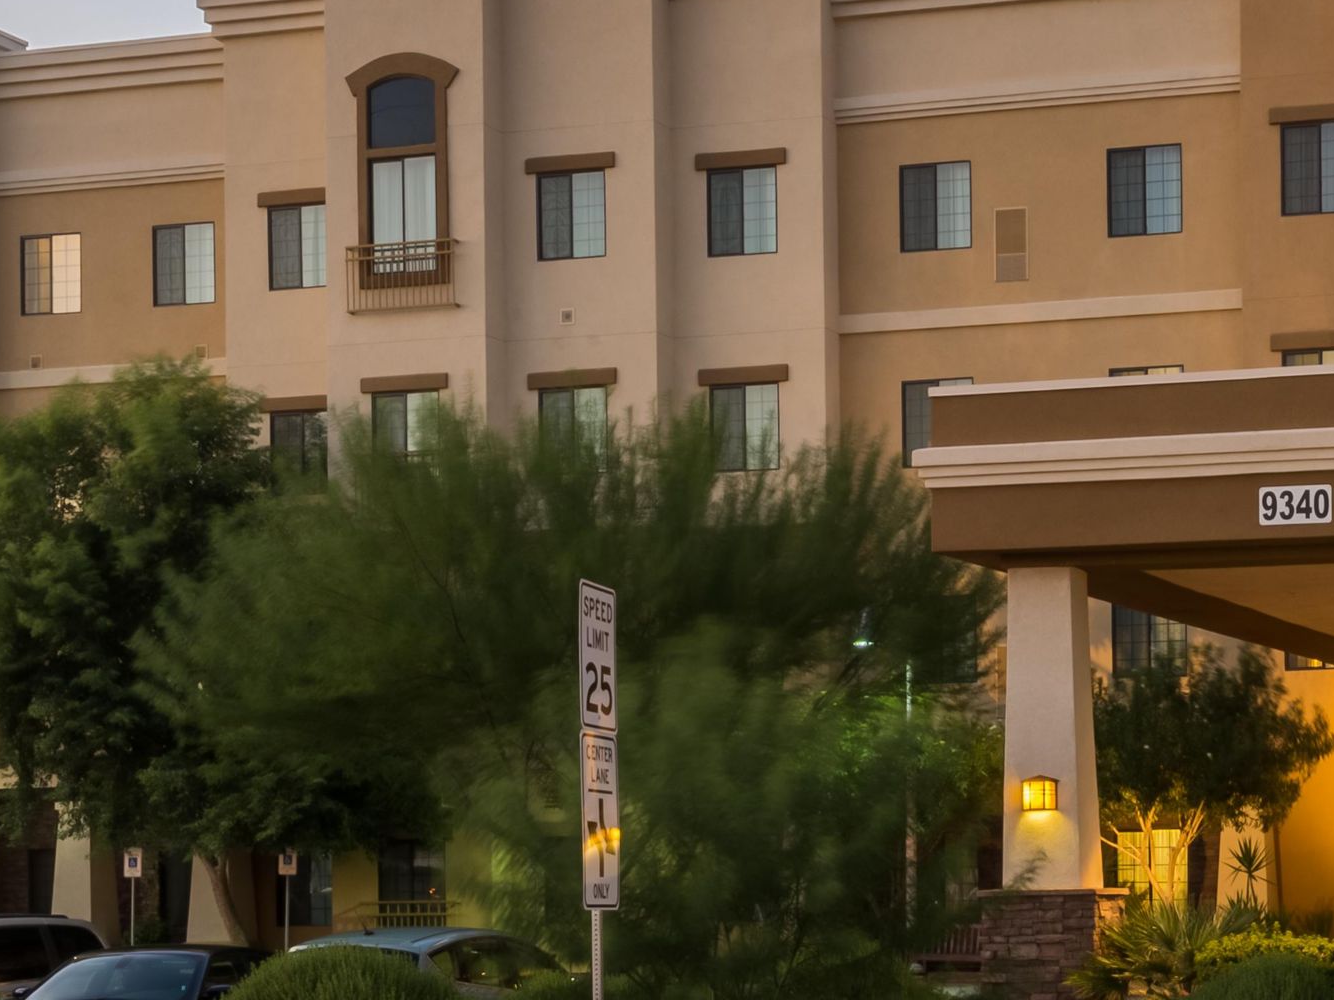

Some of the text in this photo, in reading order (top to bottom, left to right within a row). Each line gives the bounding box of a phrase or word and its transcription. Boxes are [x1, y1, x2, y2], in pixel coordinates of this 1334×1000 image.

[1262, 489, 1329, 520] 9340
[583, 595, 613, 623] SPEED
[586, 626, 610, 652] LIMIT
[585, 661, 613, 715] 25
[586, 744, 613, 763] CENTER
[590, 766, 610, 784] LANE
[593, 883, 610, 899] ONLY
